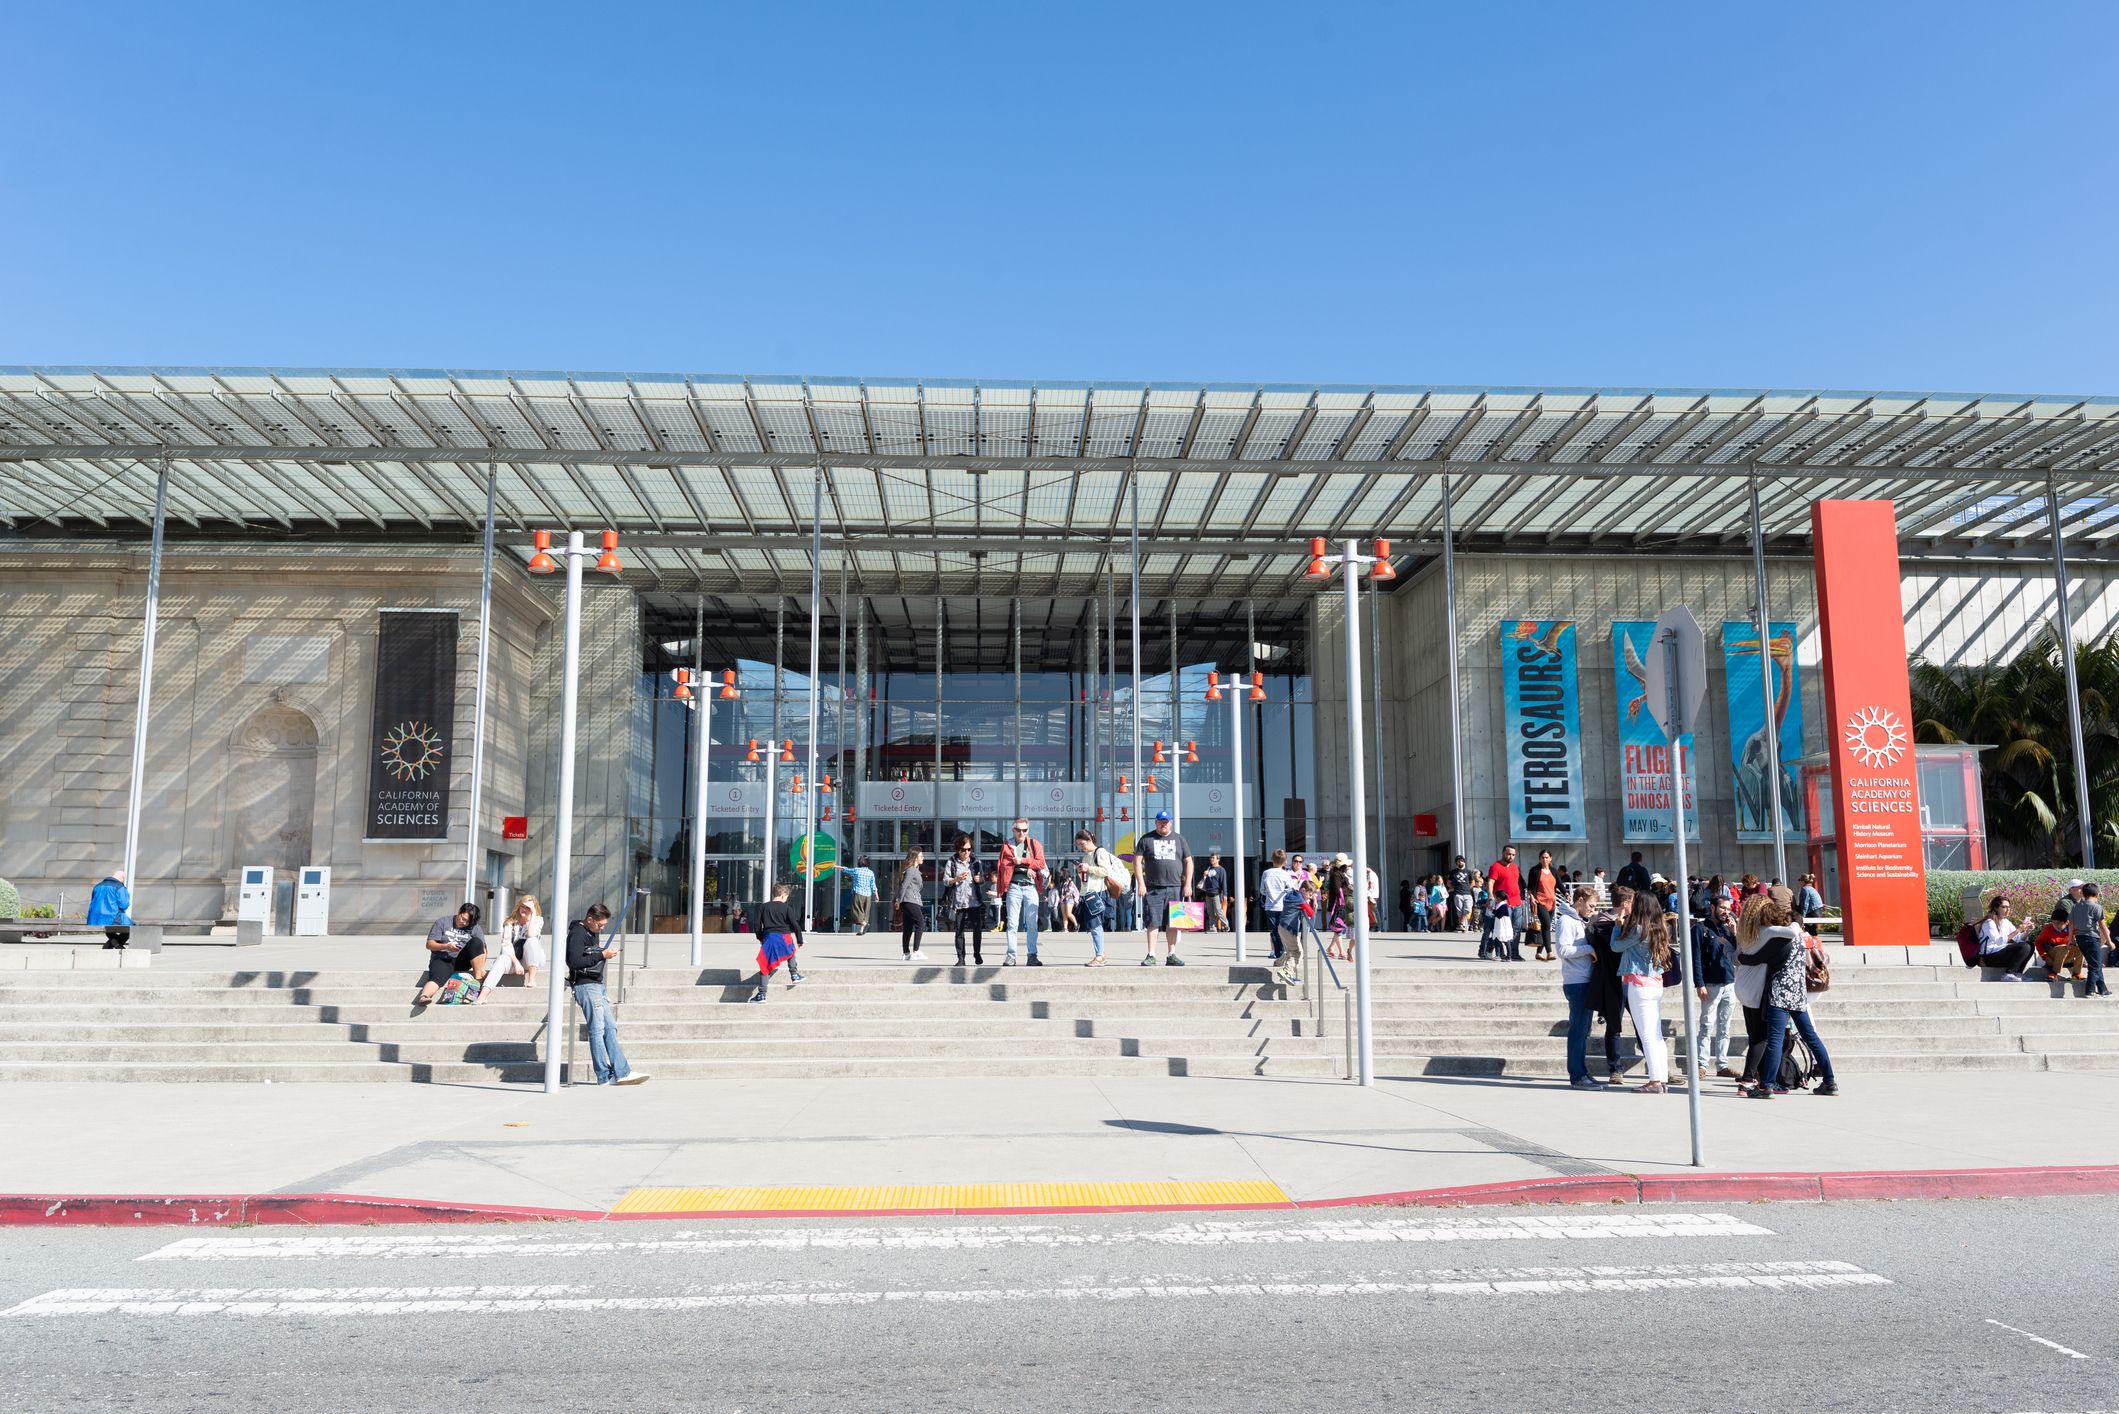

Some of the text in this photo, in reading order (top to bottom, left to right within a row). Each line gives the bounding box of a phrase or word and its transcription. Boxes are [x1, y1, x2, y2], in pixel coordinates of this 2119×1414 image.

[1516, 645, 1571, 832] PTEROSAURS
[1626, 777, 1636, 790] IN
[1640, 776, 1656, 790] THE
[1659, 776, 1672, 790] AG
[1850, 778, 1910, 787] CALIFORNIA
[378, 790, 440, 800] CALIFORNIA
[1852, 790, 1912, 798] ACADEMY OF
[378, 802, 440, 810] ACADEMY OF
[1628, 793, 1692, 809] DINOSAS
[742, 806, 760, 814] Entry
[904, 804, 922, 813] Entry
[1066, 805, 1090, 814] Groups
[1852, 802, 1912, 812] SCIENCES
[377, 814, 438, 824] SCIENCES
[1630, 820, 1647, 832] MAY
[1650, 820, 1658, 832] 19
